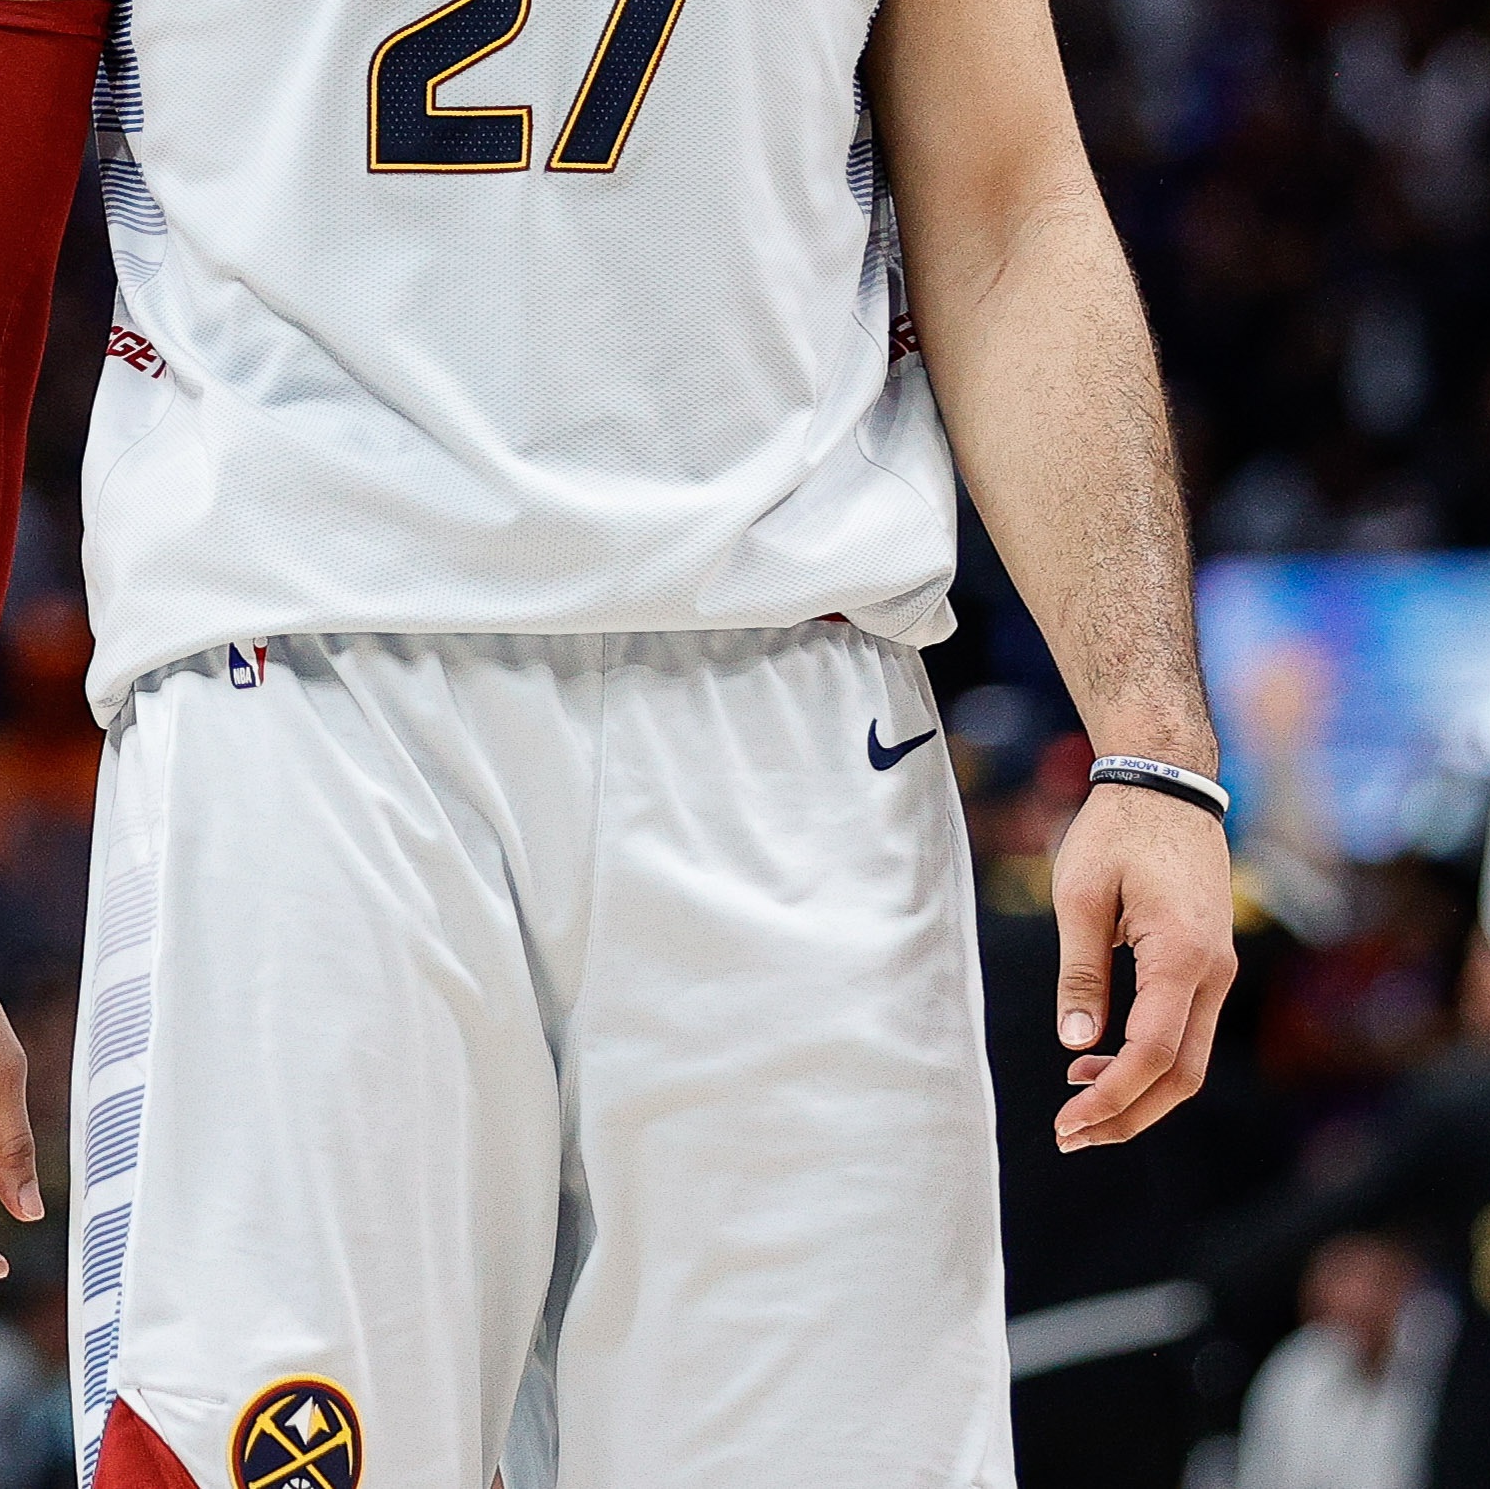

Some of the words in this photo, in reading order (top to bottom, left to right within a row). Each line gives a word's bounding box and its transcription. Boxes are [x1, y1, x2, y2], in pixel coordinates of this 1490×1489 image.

[233, 666, 253, 685] NBA
[1120, 759, 1159, 772] MORE
[1163, 768, 1180, 778] BE
